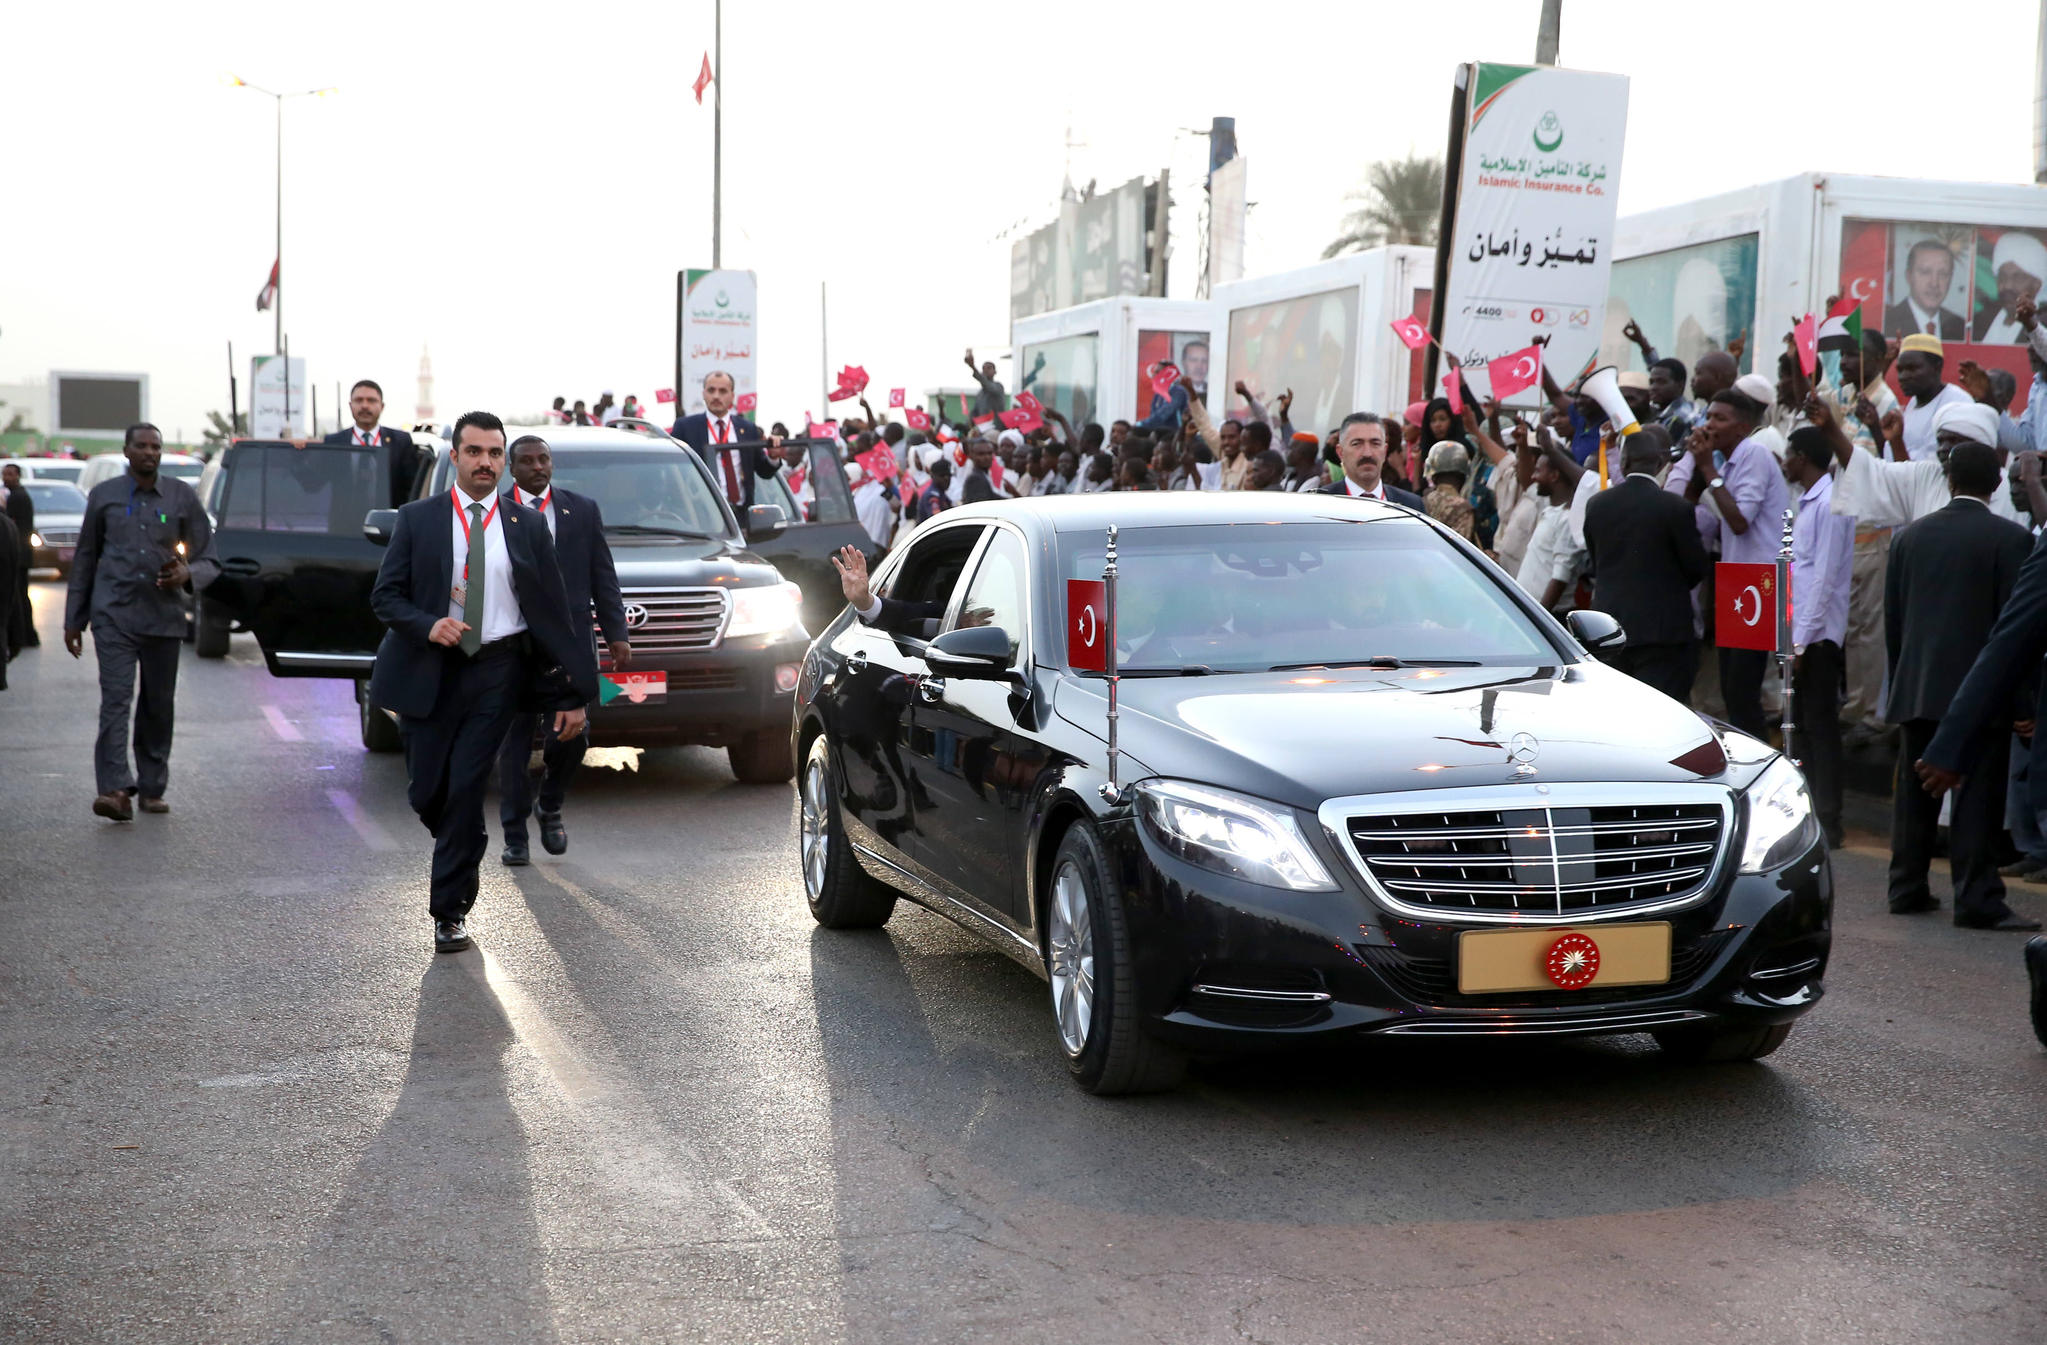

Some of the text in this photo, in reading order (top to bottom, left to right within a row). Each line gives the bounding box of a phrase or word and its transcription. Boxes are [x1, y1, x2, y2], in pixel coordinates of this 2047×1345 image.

[1577, 162, 1606, 183] شركة
[1478, 175, 1604, 195] Islamic Insurance Co.
[1469, 228, 1532, 266] وأمان
[1475, 306, 1502, 316] 4400
